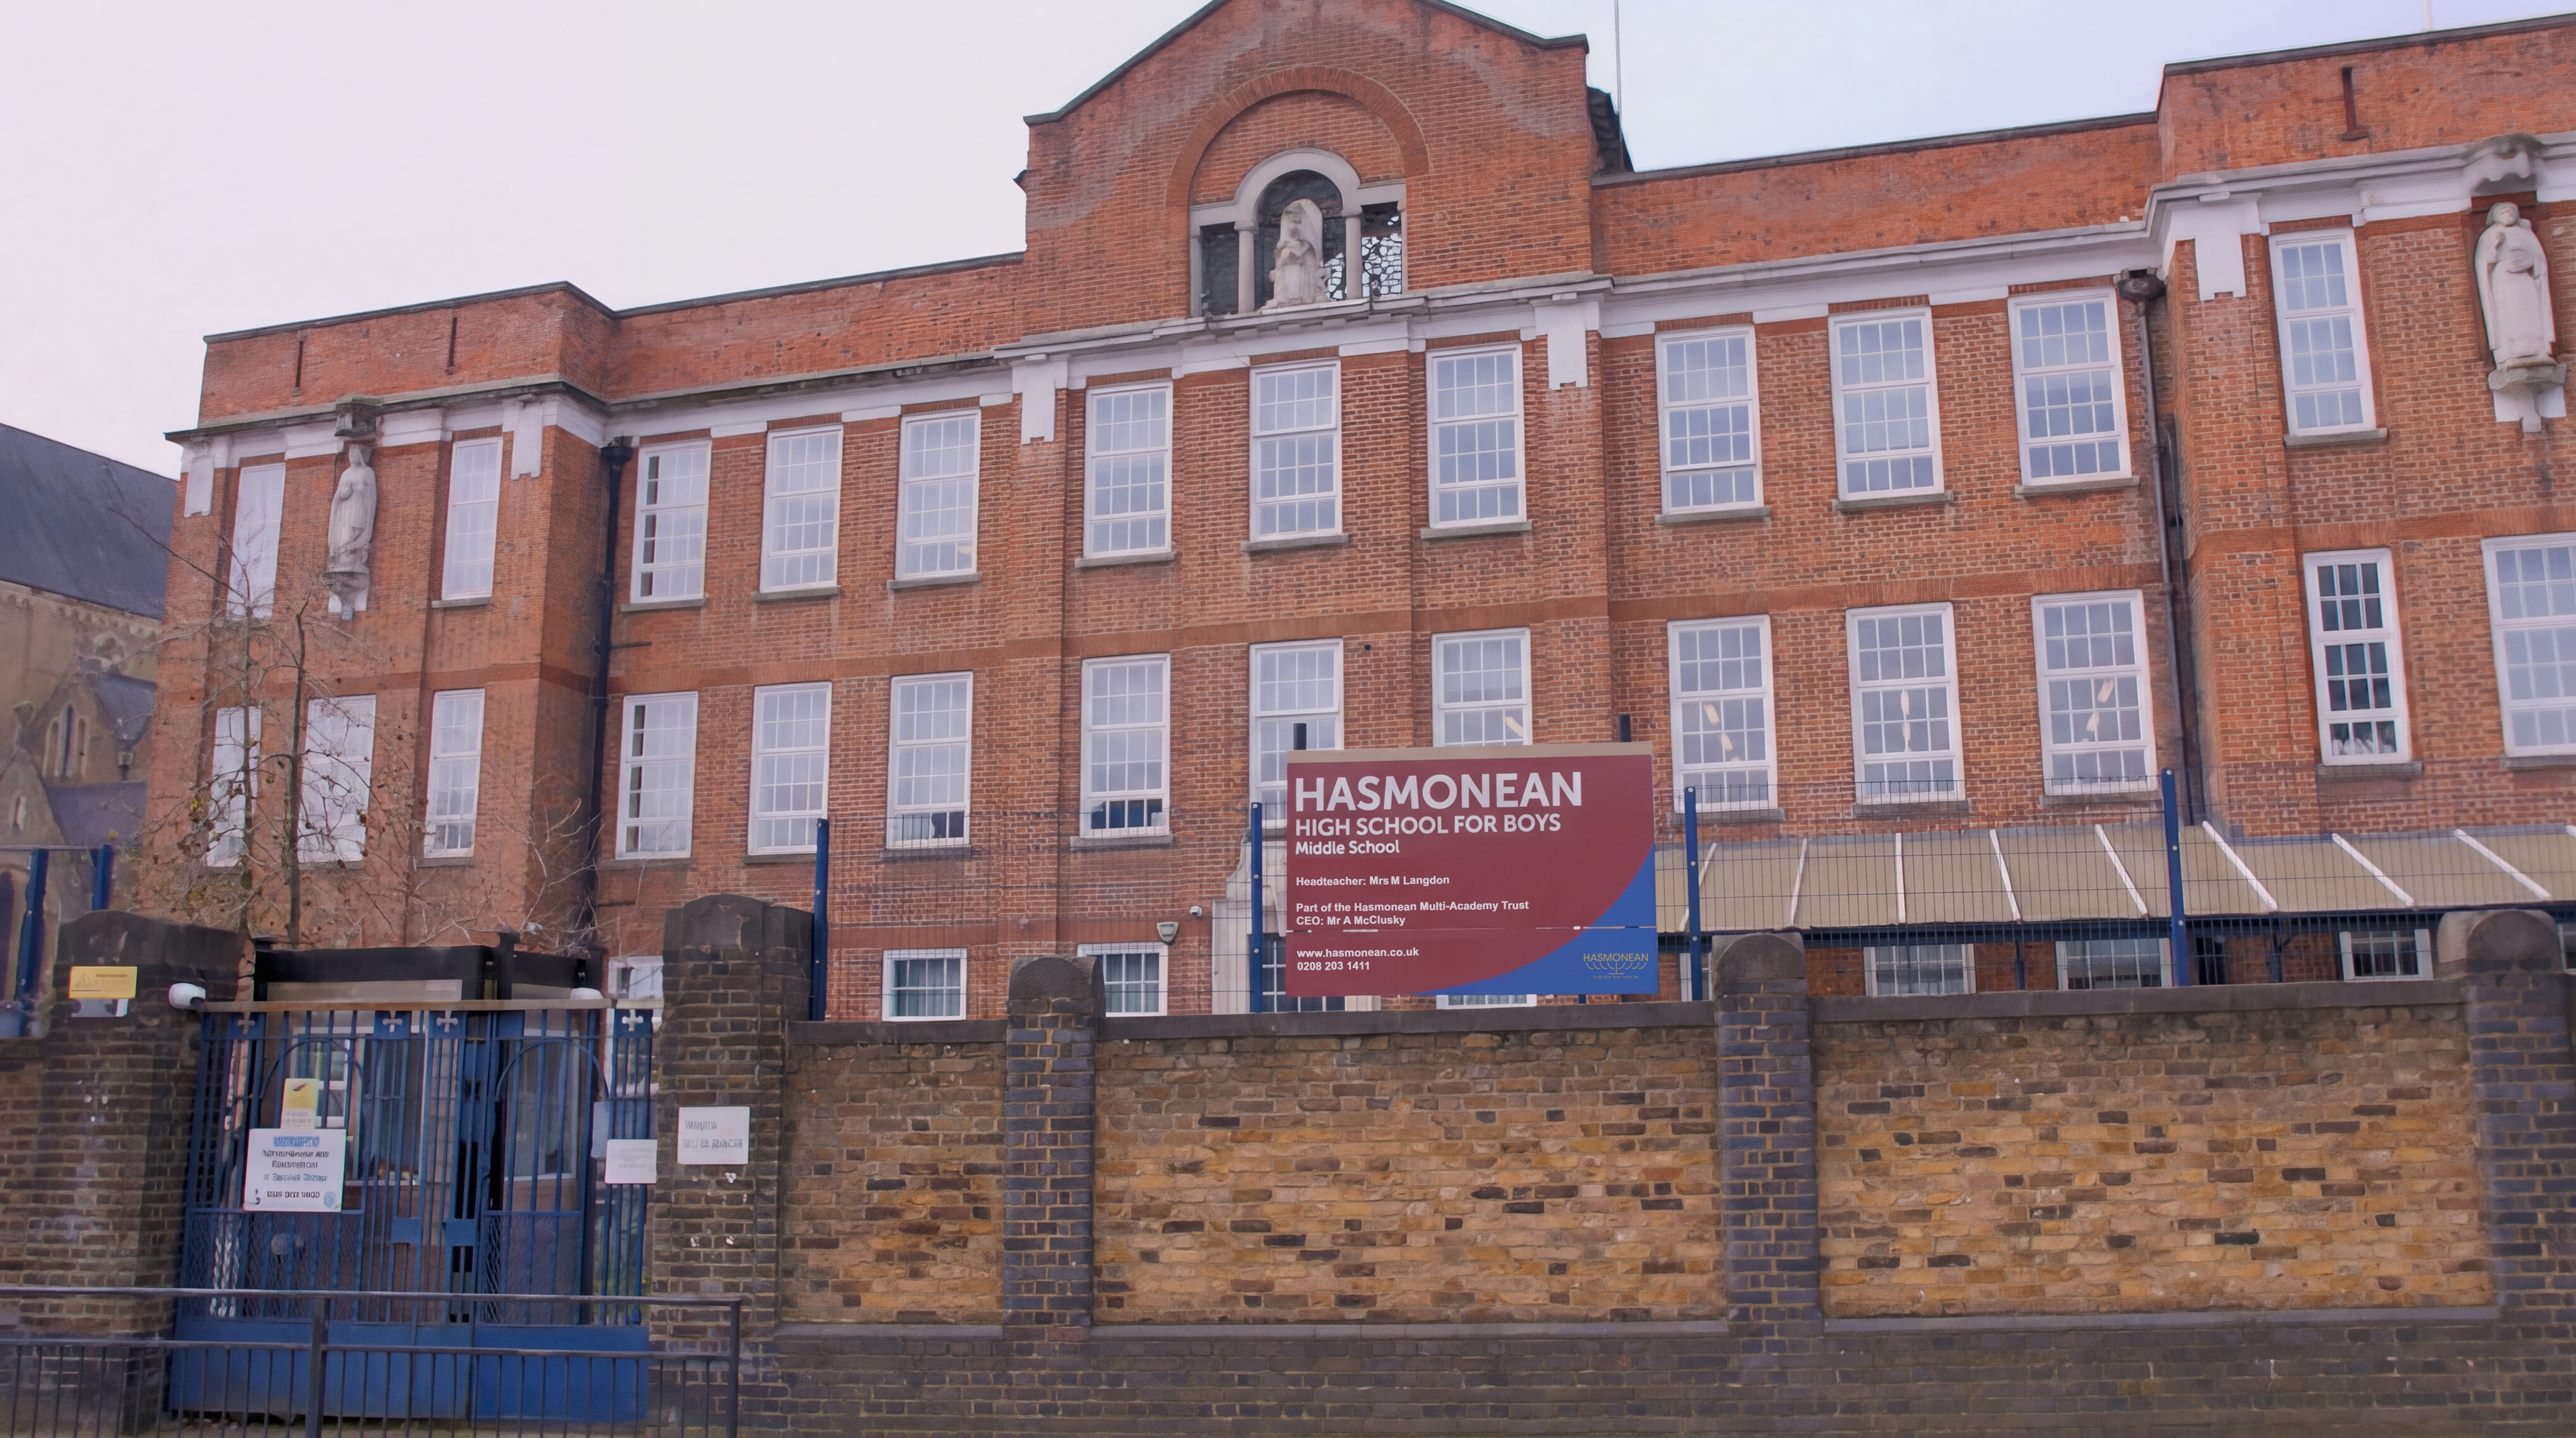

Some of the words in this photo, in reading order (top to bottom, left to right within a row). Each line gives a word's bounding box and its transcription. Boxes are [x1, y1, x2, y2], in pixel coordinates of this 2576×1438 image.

[1295, 771, 1582, 812] HASMONEAN
[1295, 818, 1350, 836] HIGH
[1356, 816, 1449, 836] SCHOOL
[1454, 814, 1498, 833] FOR
[1504, 813, 1561, 832] BOYS
[1295, 841, 1345, 855] Middle
[1348, 839, 1400, 854] School
[1296, 877, 1366, 886] Headteacher:
[1369, 876, 1389, 885] Mrs
[1390, 876, 1400, 885] M
[1403, 875, 1449, 887] Langdon
[1296, 903, 1318, 912] Part
[1320, 903, 1332, 912] of
[1334, 902, 1351, 911] the
[1354, 902, 1417, 912] Hasmonean
[1420, 901, 1499, 912] Multi-Academy
[1501, 901, 1529, 910] Trust
[1296, 916, 1324, 925] CEO:
[1327, 916, 1341, 925] Mr
[1343, 916, 1352, 924] A
[1354, 915, 1406, 926] McClusky
[1296, 947, 1420, 958] www.hasmonean.co.uk
[1583, 953, 1648, 962] HASMONEAN
[1297, 961, 1322, 971] 0208
[1325, 961, 1344, 970] 203
[1347, 961, 1369, 970] 1411
